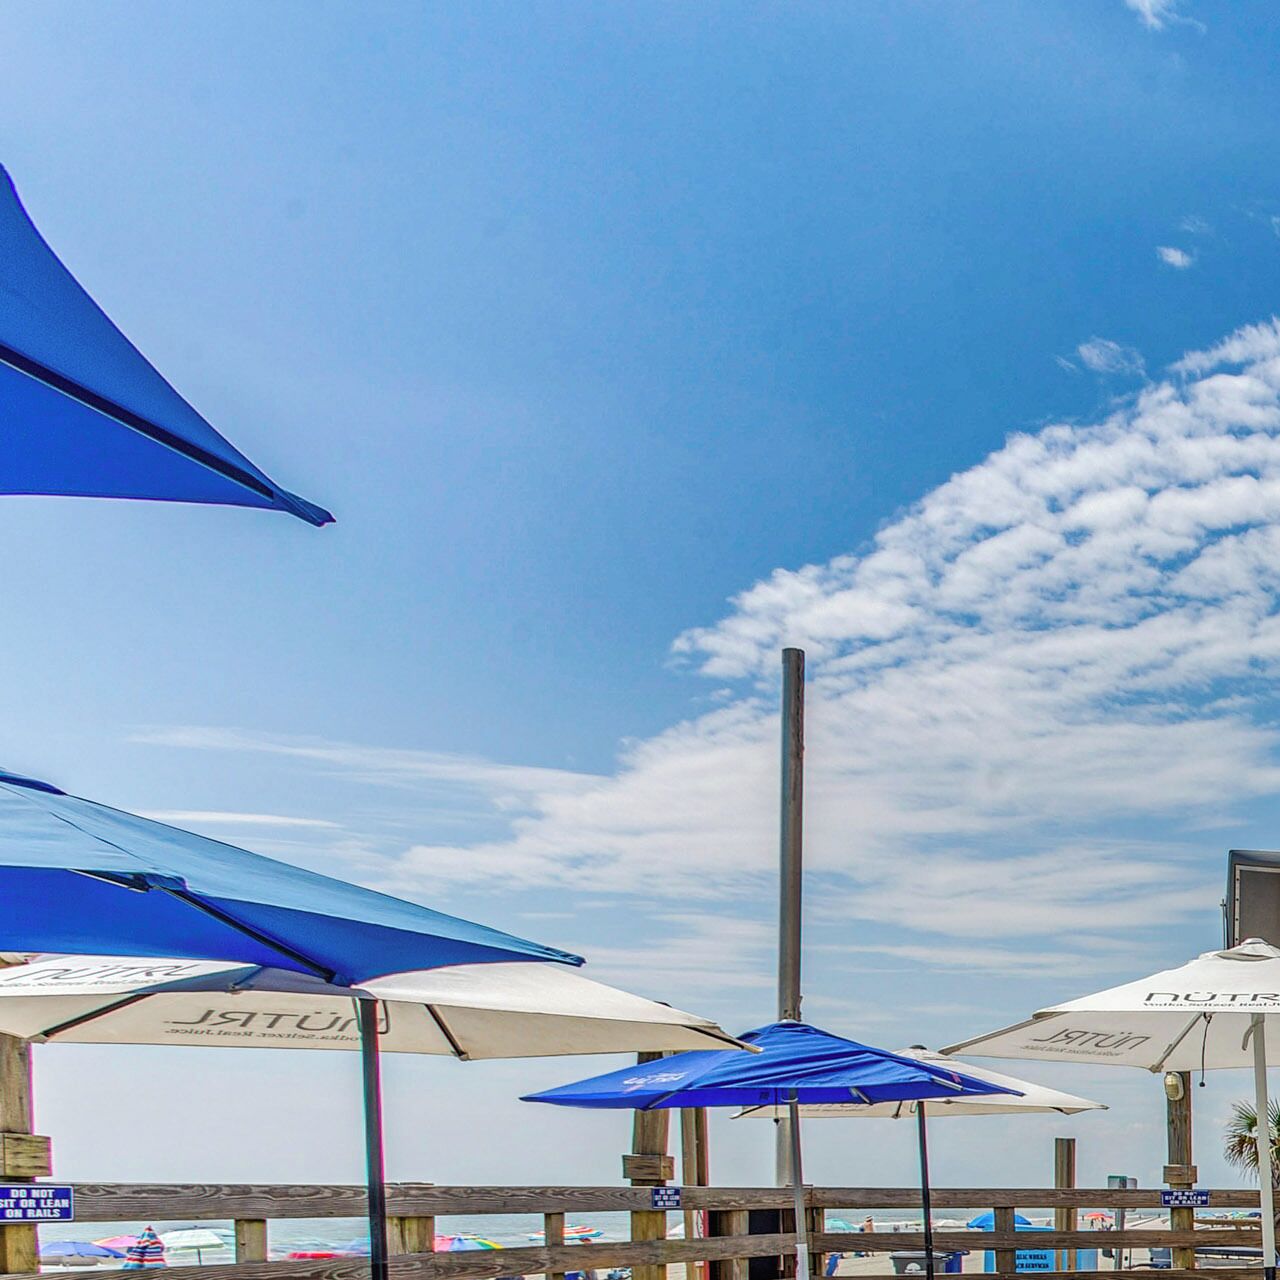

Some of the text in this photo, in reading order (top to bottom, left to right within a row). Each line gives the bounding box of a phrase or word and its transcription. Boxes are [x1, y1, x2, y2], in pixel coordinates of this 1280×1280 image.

[10, 1188, 56, 1198] DO NOT
[0, 1198, 69, 1208] SIT OR LEAN
[5, 1208, 62, 1218] ON RAILS
